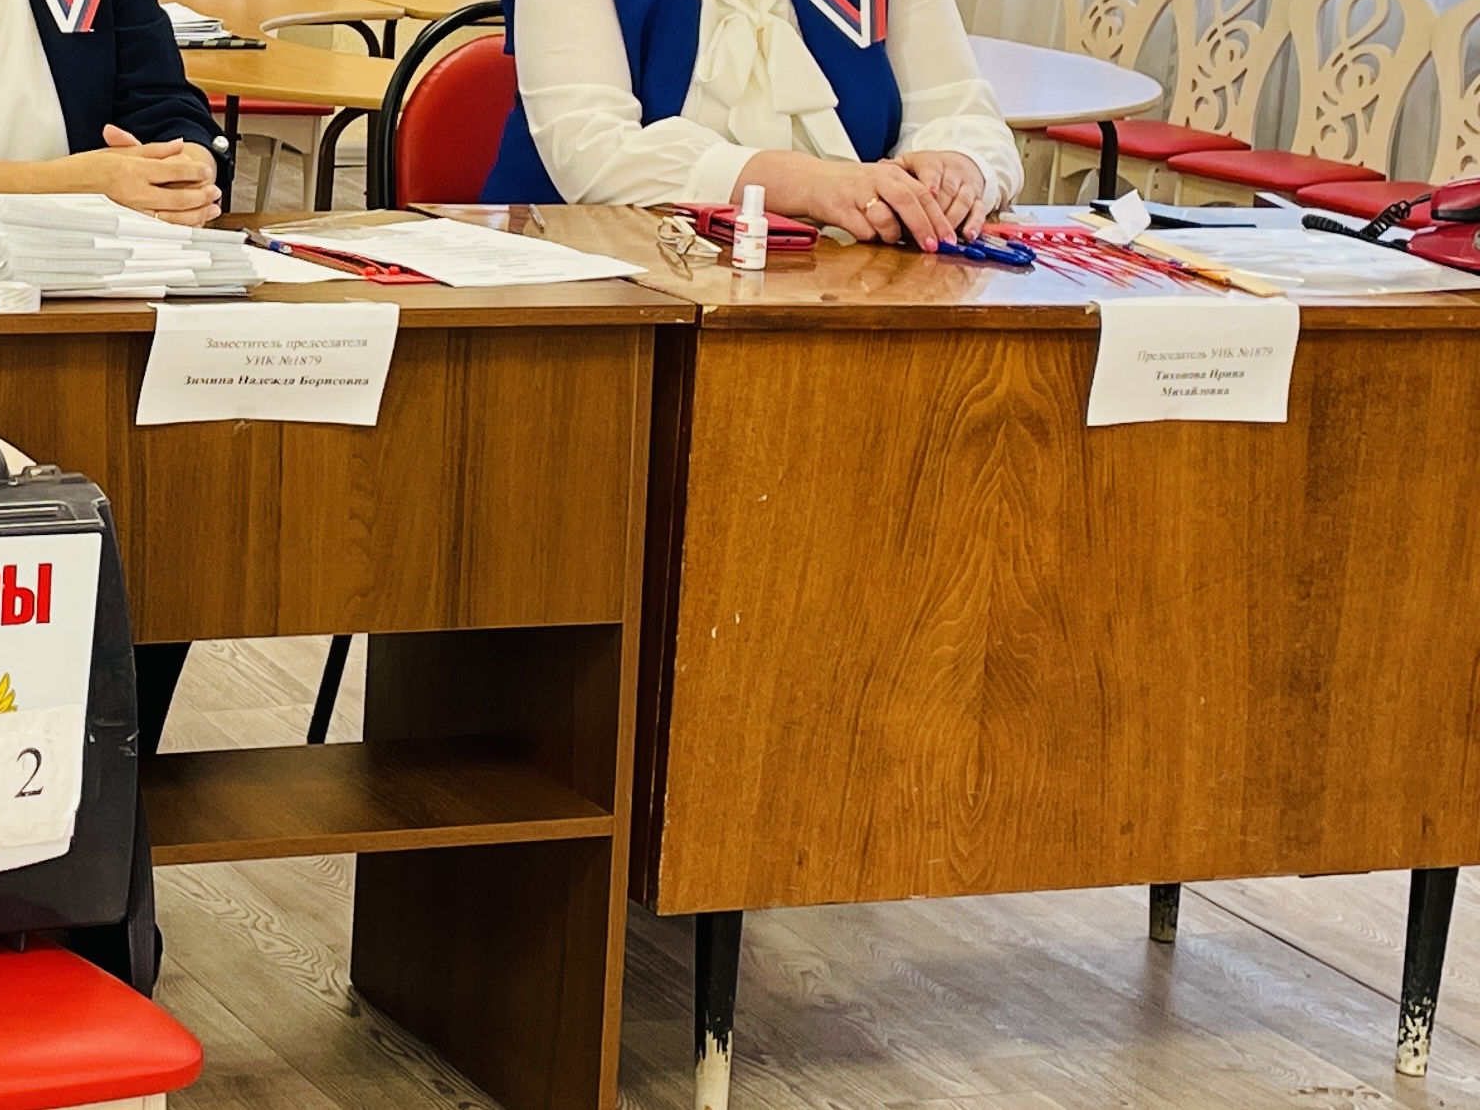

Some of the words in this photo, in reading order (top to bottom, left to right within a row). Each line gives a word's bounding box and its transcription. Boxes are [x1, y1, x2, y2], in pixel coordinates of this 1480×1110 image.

[204, 337, 282, 349] Заместитель
[286, 337, 368, 351] председателя
[244, 355, 275, 366] УИК
[278, 355, 322, 366] №1879
[1137, 349, 1207, 364] Председатель
[1210, 348, 1235, 359] УИК
[1237, 346, 1273, 358] №1879
[183, 375, 234, 385] Зимина
[238, 376, 295, 386] Надежда
[299, 376, 369, 388] Борисовна
[1155, 370, 1206, 380] Тихонова
[1210, 369, 1245, 382] Ирина
[1160, 387, 1230, 397] Михайловна
[13, 747, 45, 798] 2
